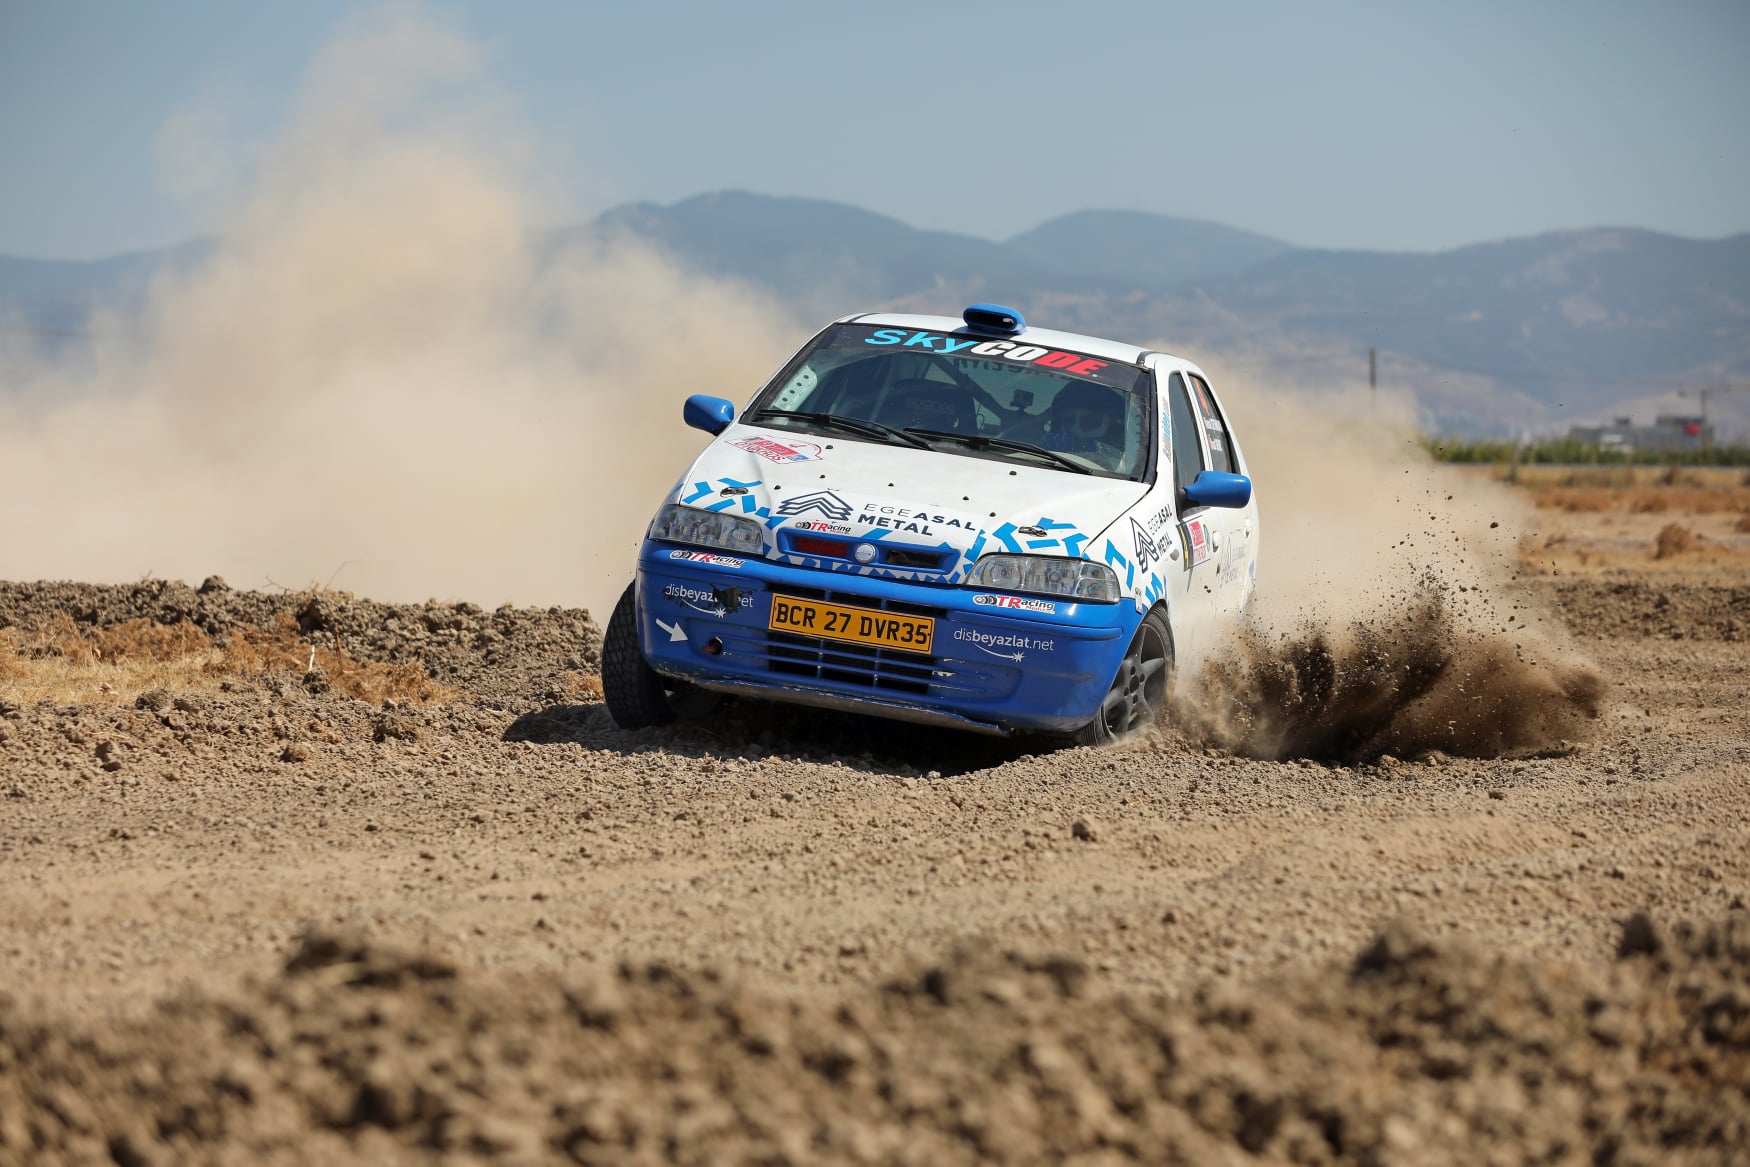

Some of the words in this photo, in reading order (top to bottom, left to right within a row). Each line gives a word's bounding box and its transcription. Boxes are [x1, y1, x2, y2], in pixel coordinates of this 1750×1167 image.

[857, 513, 933, 537] METAL
[775, 602, 816, 628] BCR
[823, 610, 852, 633] 27
[859, 615, 929, 645] DVR35
[953, 627, 1054, 651] disbeyazlat.net
